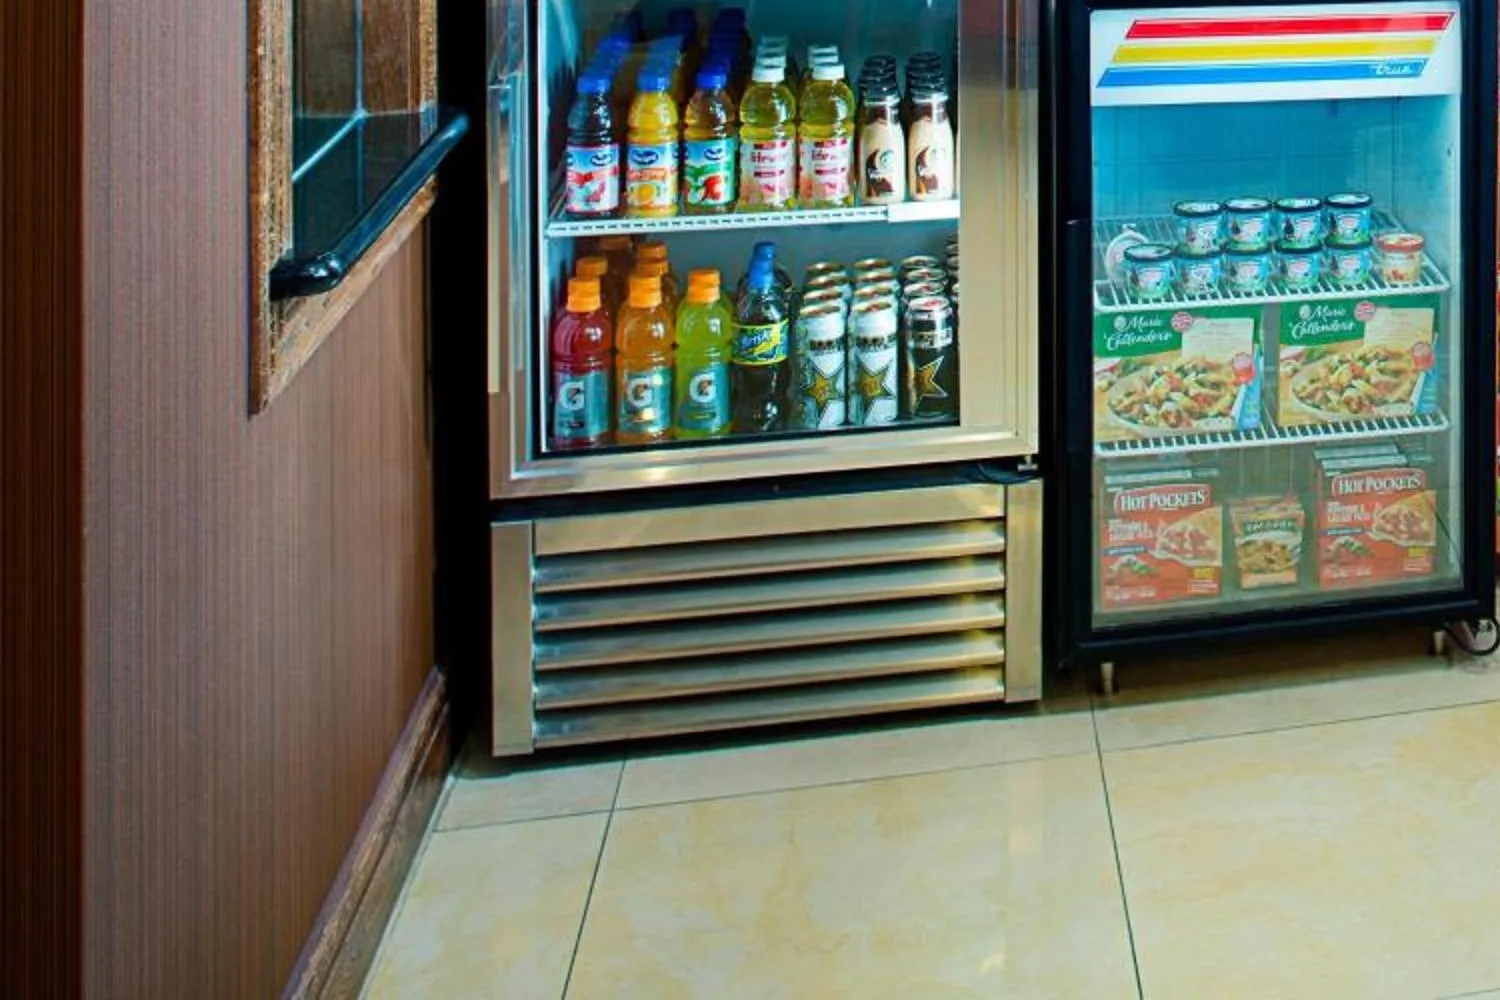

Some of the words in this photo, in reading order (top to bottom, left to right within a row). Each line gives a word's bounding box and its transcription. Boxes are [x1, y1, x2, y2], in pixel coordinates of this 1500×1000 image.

[560, 382, 585, 411] G
[627, 377, 653, 408] G
[689, 372, 716, 403] G
[1121, 494, 1147, 511] HOT
[1149, 490, 1208, 509] POCKETS
